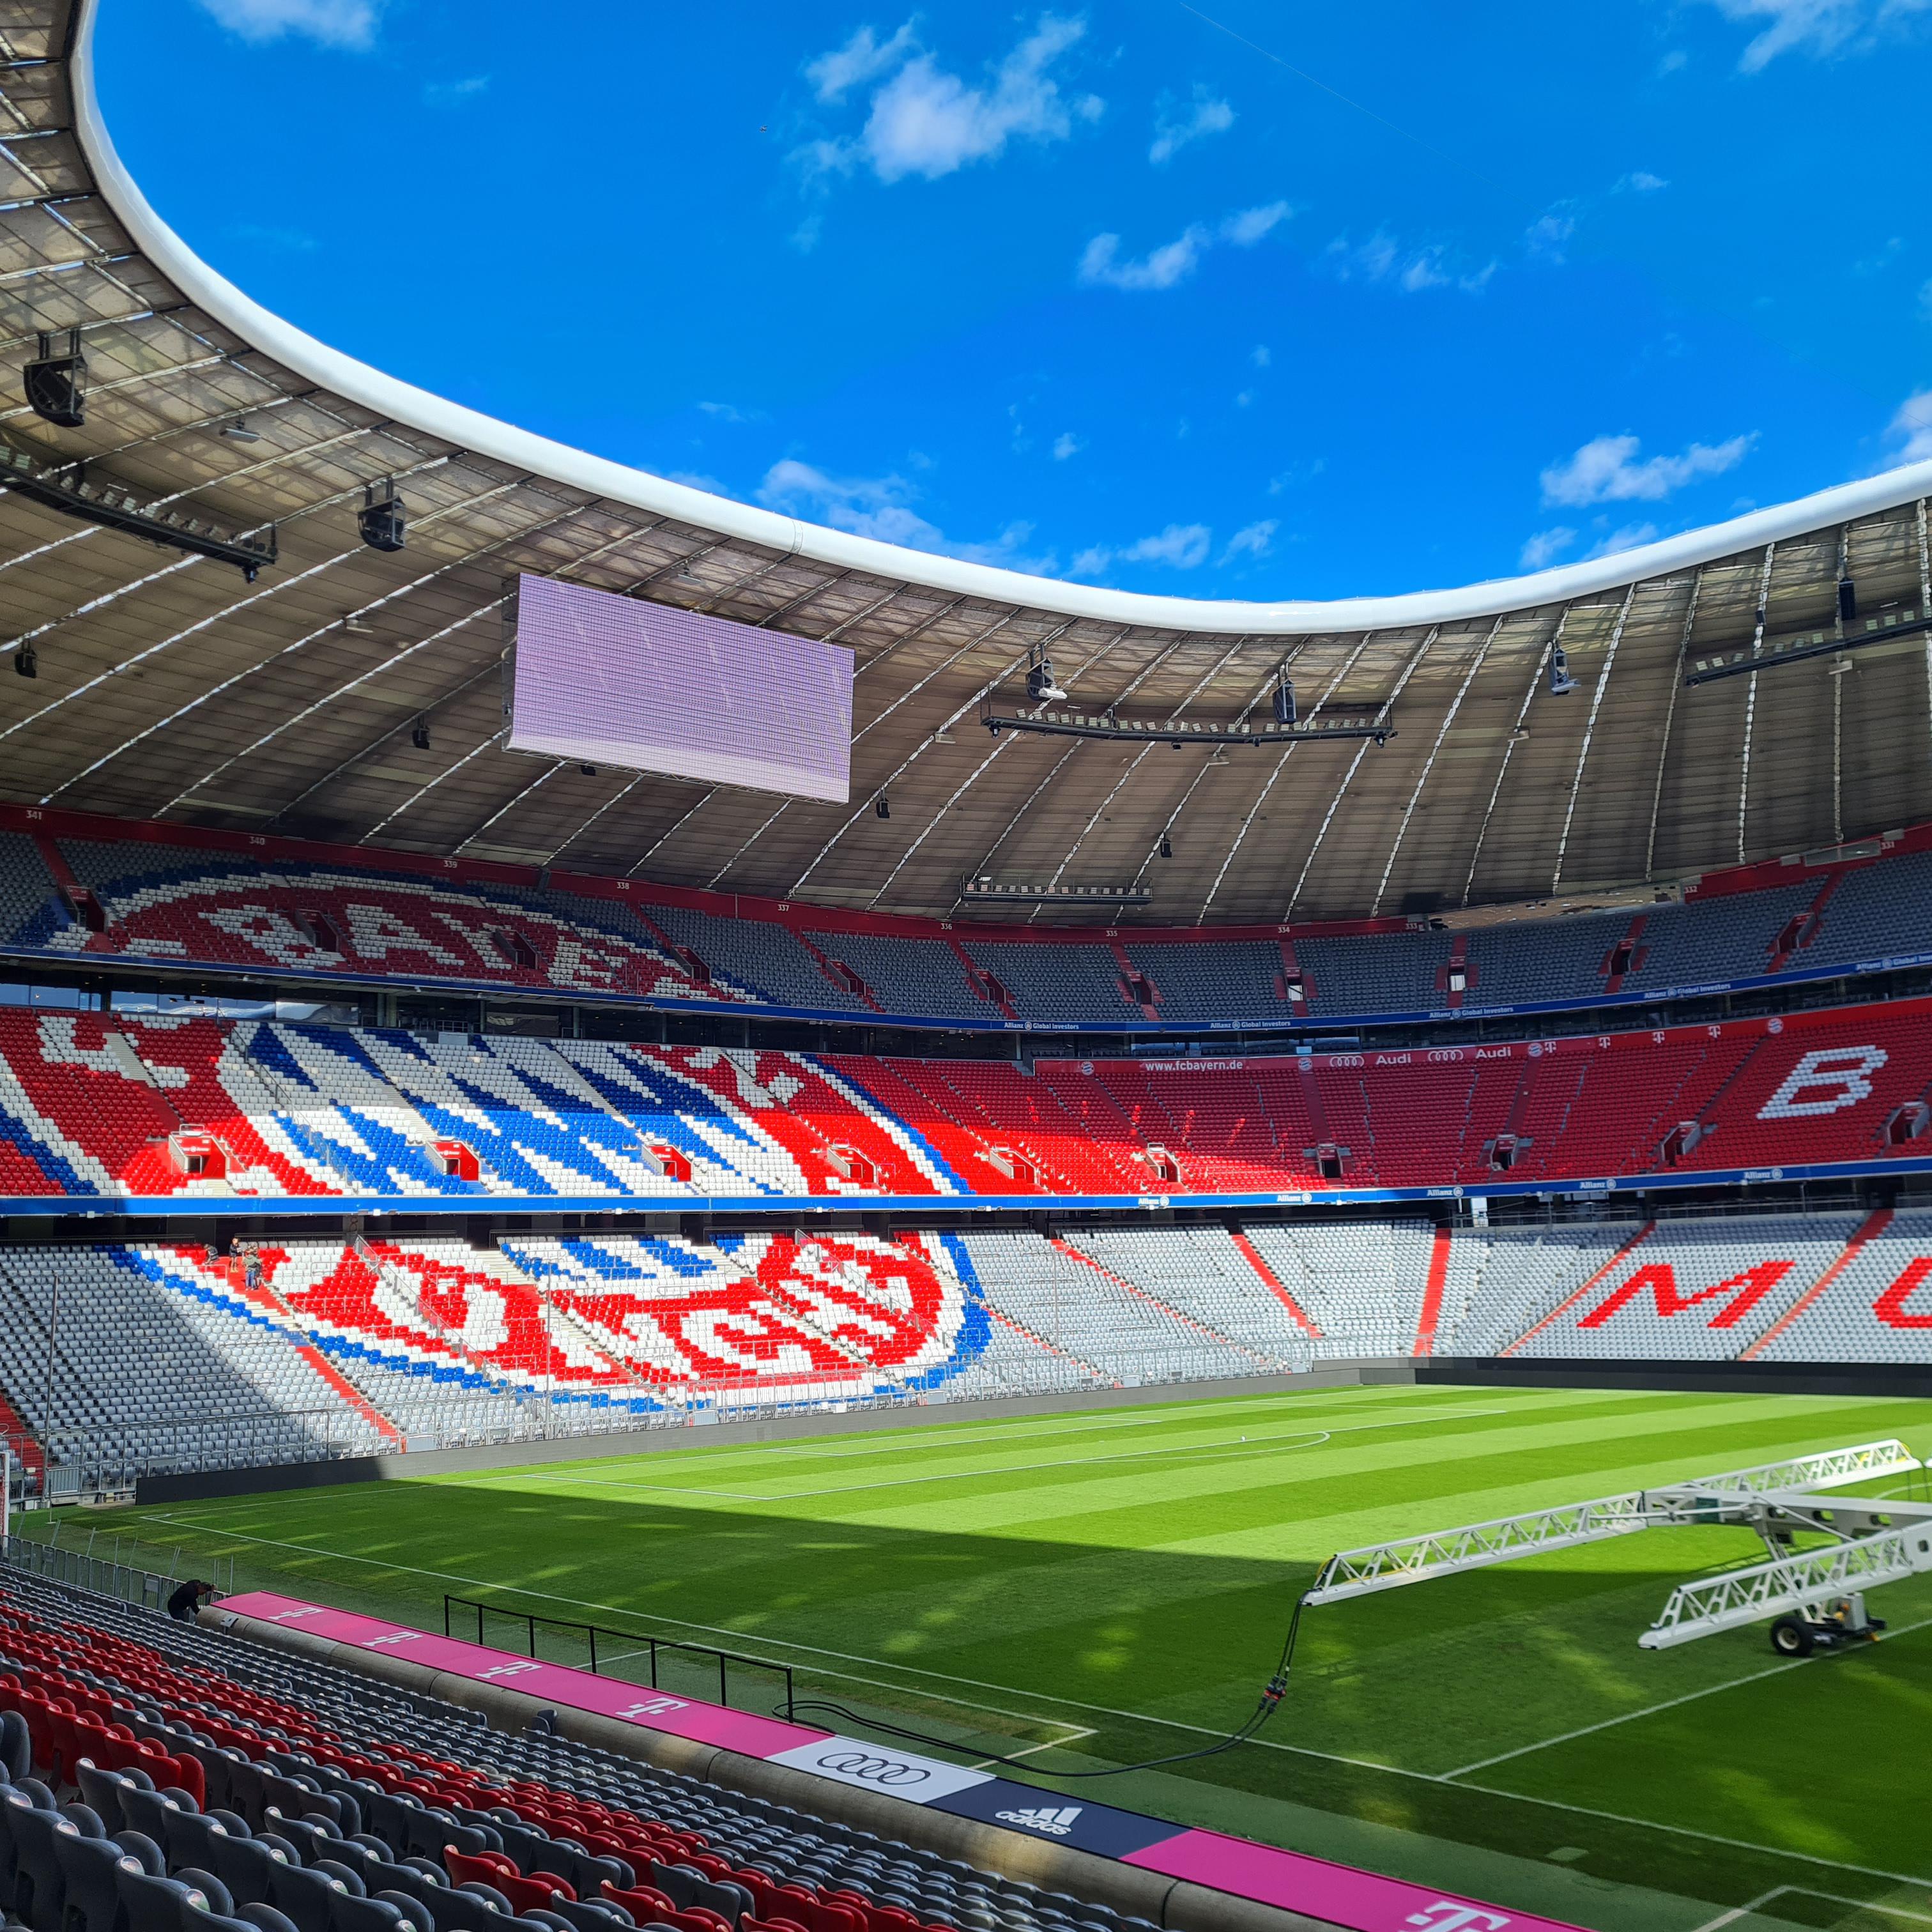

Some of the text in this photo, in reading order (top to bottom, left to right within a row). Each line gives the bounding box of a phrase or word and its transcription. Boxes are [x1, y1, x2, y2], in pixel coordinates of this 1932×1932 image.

[26, 810, 42, 820] 341
[250, 836, 265, 845] 340
[443, 860, 458, 869] 339
[616, 882, 630, 890] 338
[1475, 1046, 1511, 1059] Audi
[1376, 1053, 1411, 1065] Audi
[1146, 1060, 1243, 1072] www.fcbayern.de
[1756, 1045, 1889, 1119] B
[995, 1811, 1072, 1835] adidas
